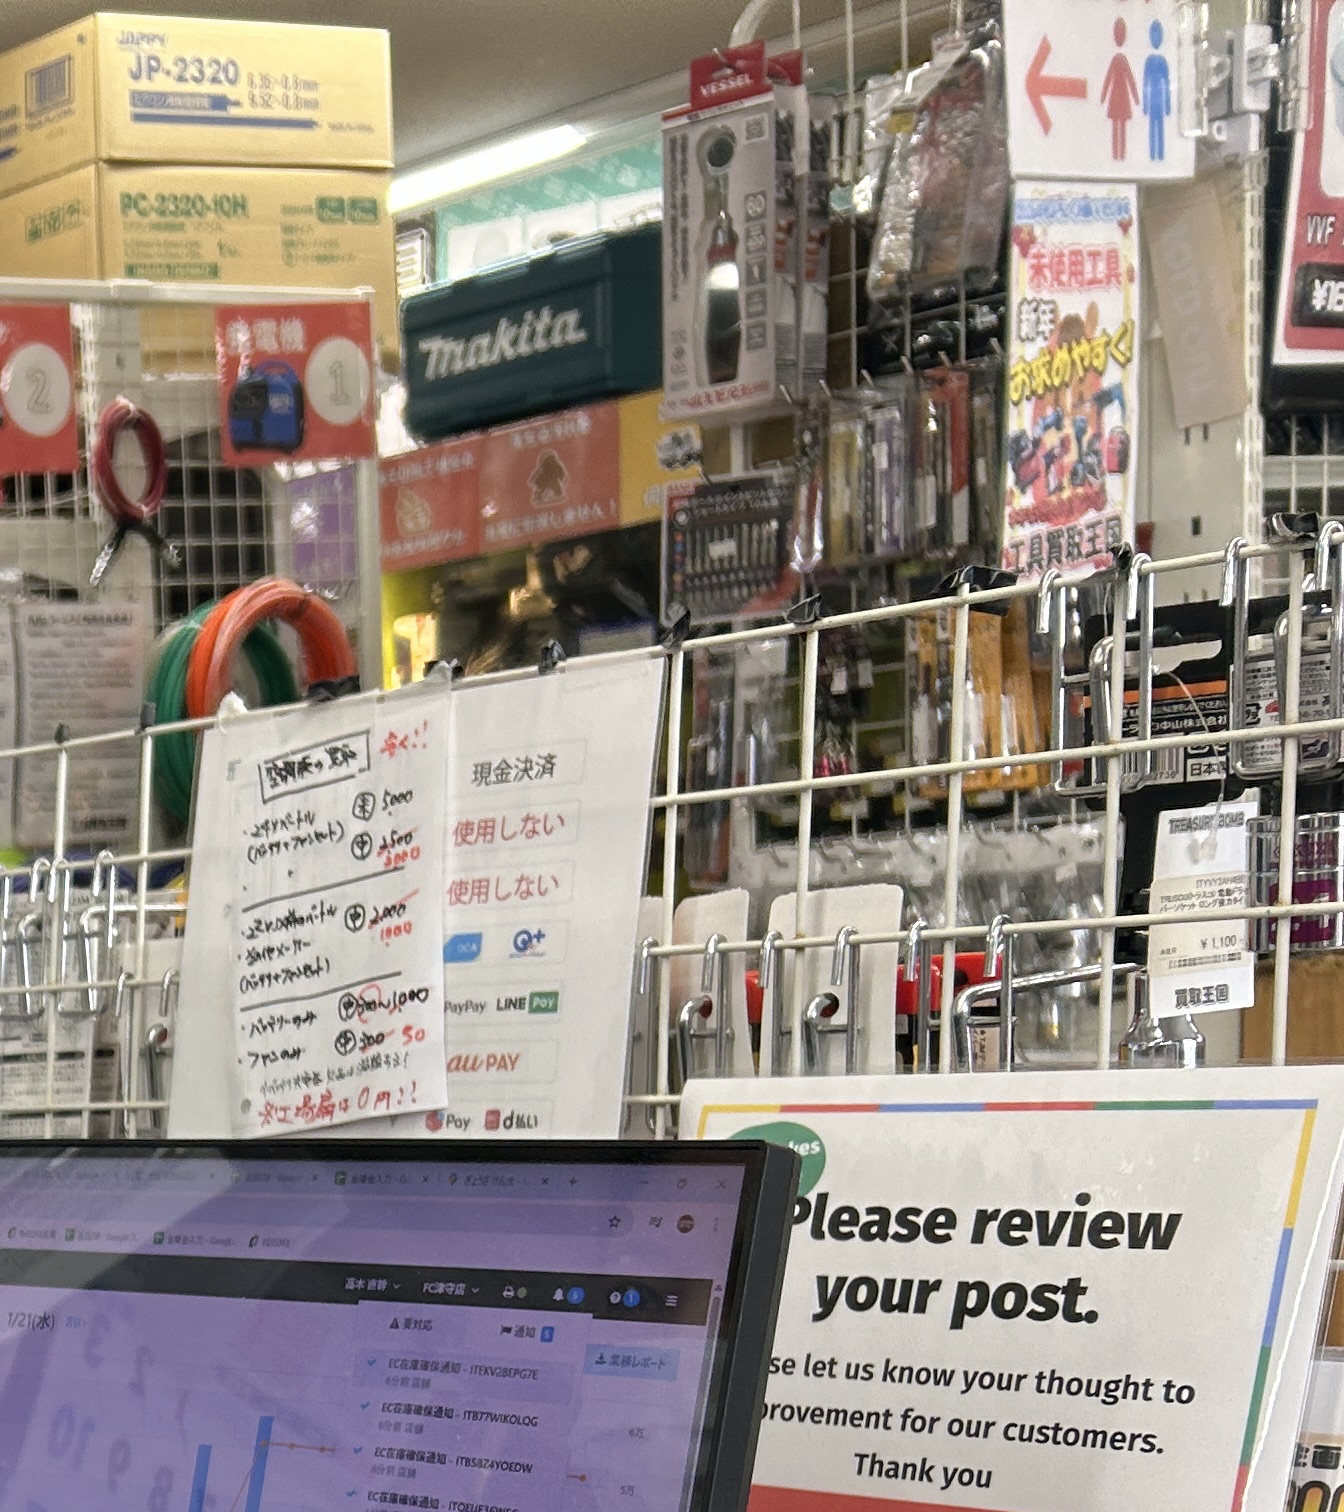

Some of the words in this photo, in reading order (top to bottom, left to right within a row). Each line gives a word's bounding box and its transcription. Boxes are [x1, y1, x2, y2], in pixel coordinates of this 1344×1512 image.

[128, 55, 240, 86] JP-2320
[700, 73, 755, 98] VESSEL
[471, 753, 558, 788] 現金決済
[453, 811, 567, 847] 使用しない
[447, 872, 561, 907] 使用しない
[1211, 934, 1237, 949] 1,100
[496, 997, 527, 1012] LINE
[1174, 984, 1230, 1010] 買取王国
[485, 1052, 522, 1073] PAY
[790, 1190, 957, 1246] Please
[969, 1191, 1183, 1251] review
[810, 1272, 943, 1323] your
[948, 1275, 1099, 1332] post.
[5, 1311, 56, 1332] 1/21(水)
[802, 1354, 838, 1382] let
[844, 1359, 875, 1384] us
[881, 1358, 956, 1389] know
[961, 1368, 1028, 1397] your
[1034, 1370, 1154, 1407] thought
[1161, 1378, 1196, 1406] to
[899, 1407, 941, 1435] for
[947, 1416, 995, 1441] our
[1002, 1417, 1165, 1456] customers.
[853, 1453, 933, 1484] Thank
[941, 1463, 993, 1491] you
